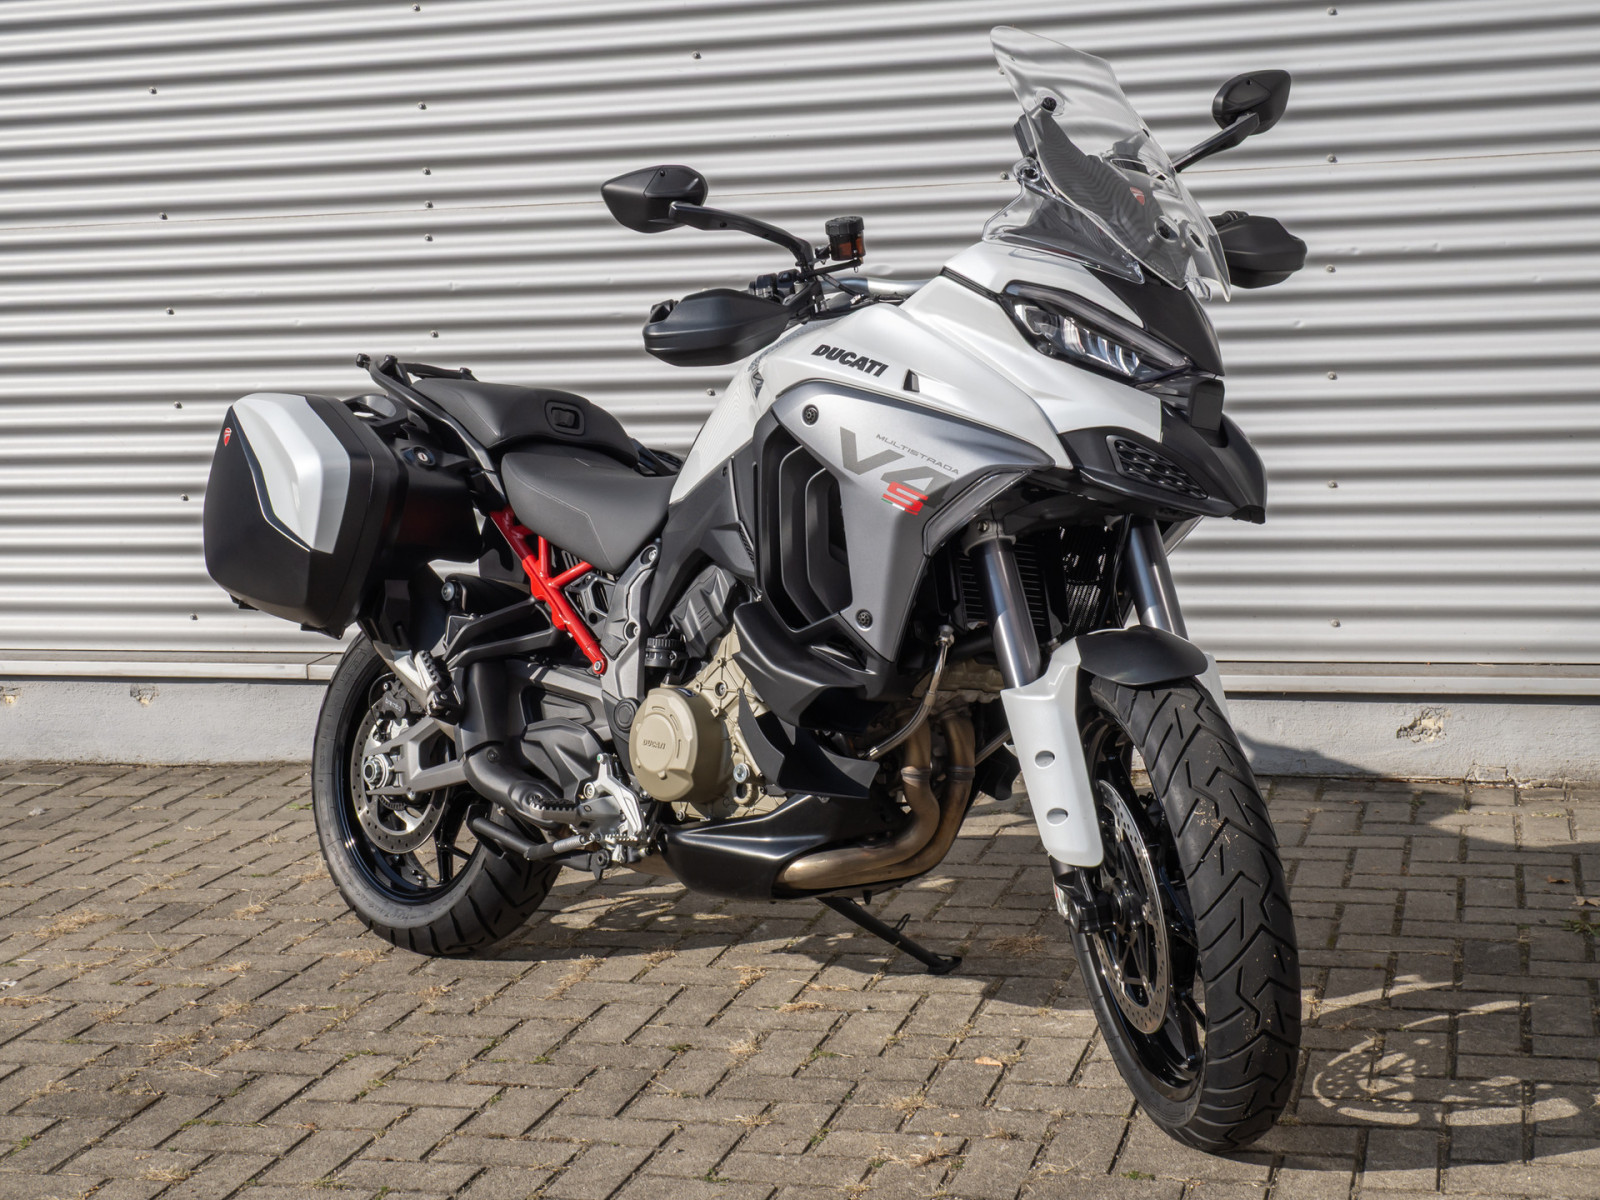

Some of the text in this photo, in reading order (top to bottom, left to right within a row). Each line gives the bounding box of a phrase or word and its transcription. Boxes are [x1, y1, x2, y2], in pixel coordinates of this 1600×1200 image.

[811, 344, 889, 378] DUCATI
[876, 434, 959, 474] MULTISTRADA
[642, 738, 666, 750] DUCATI
